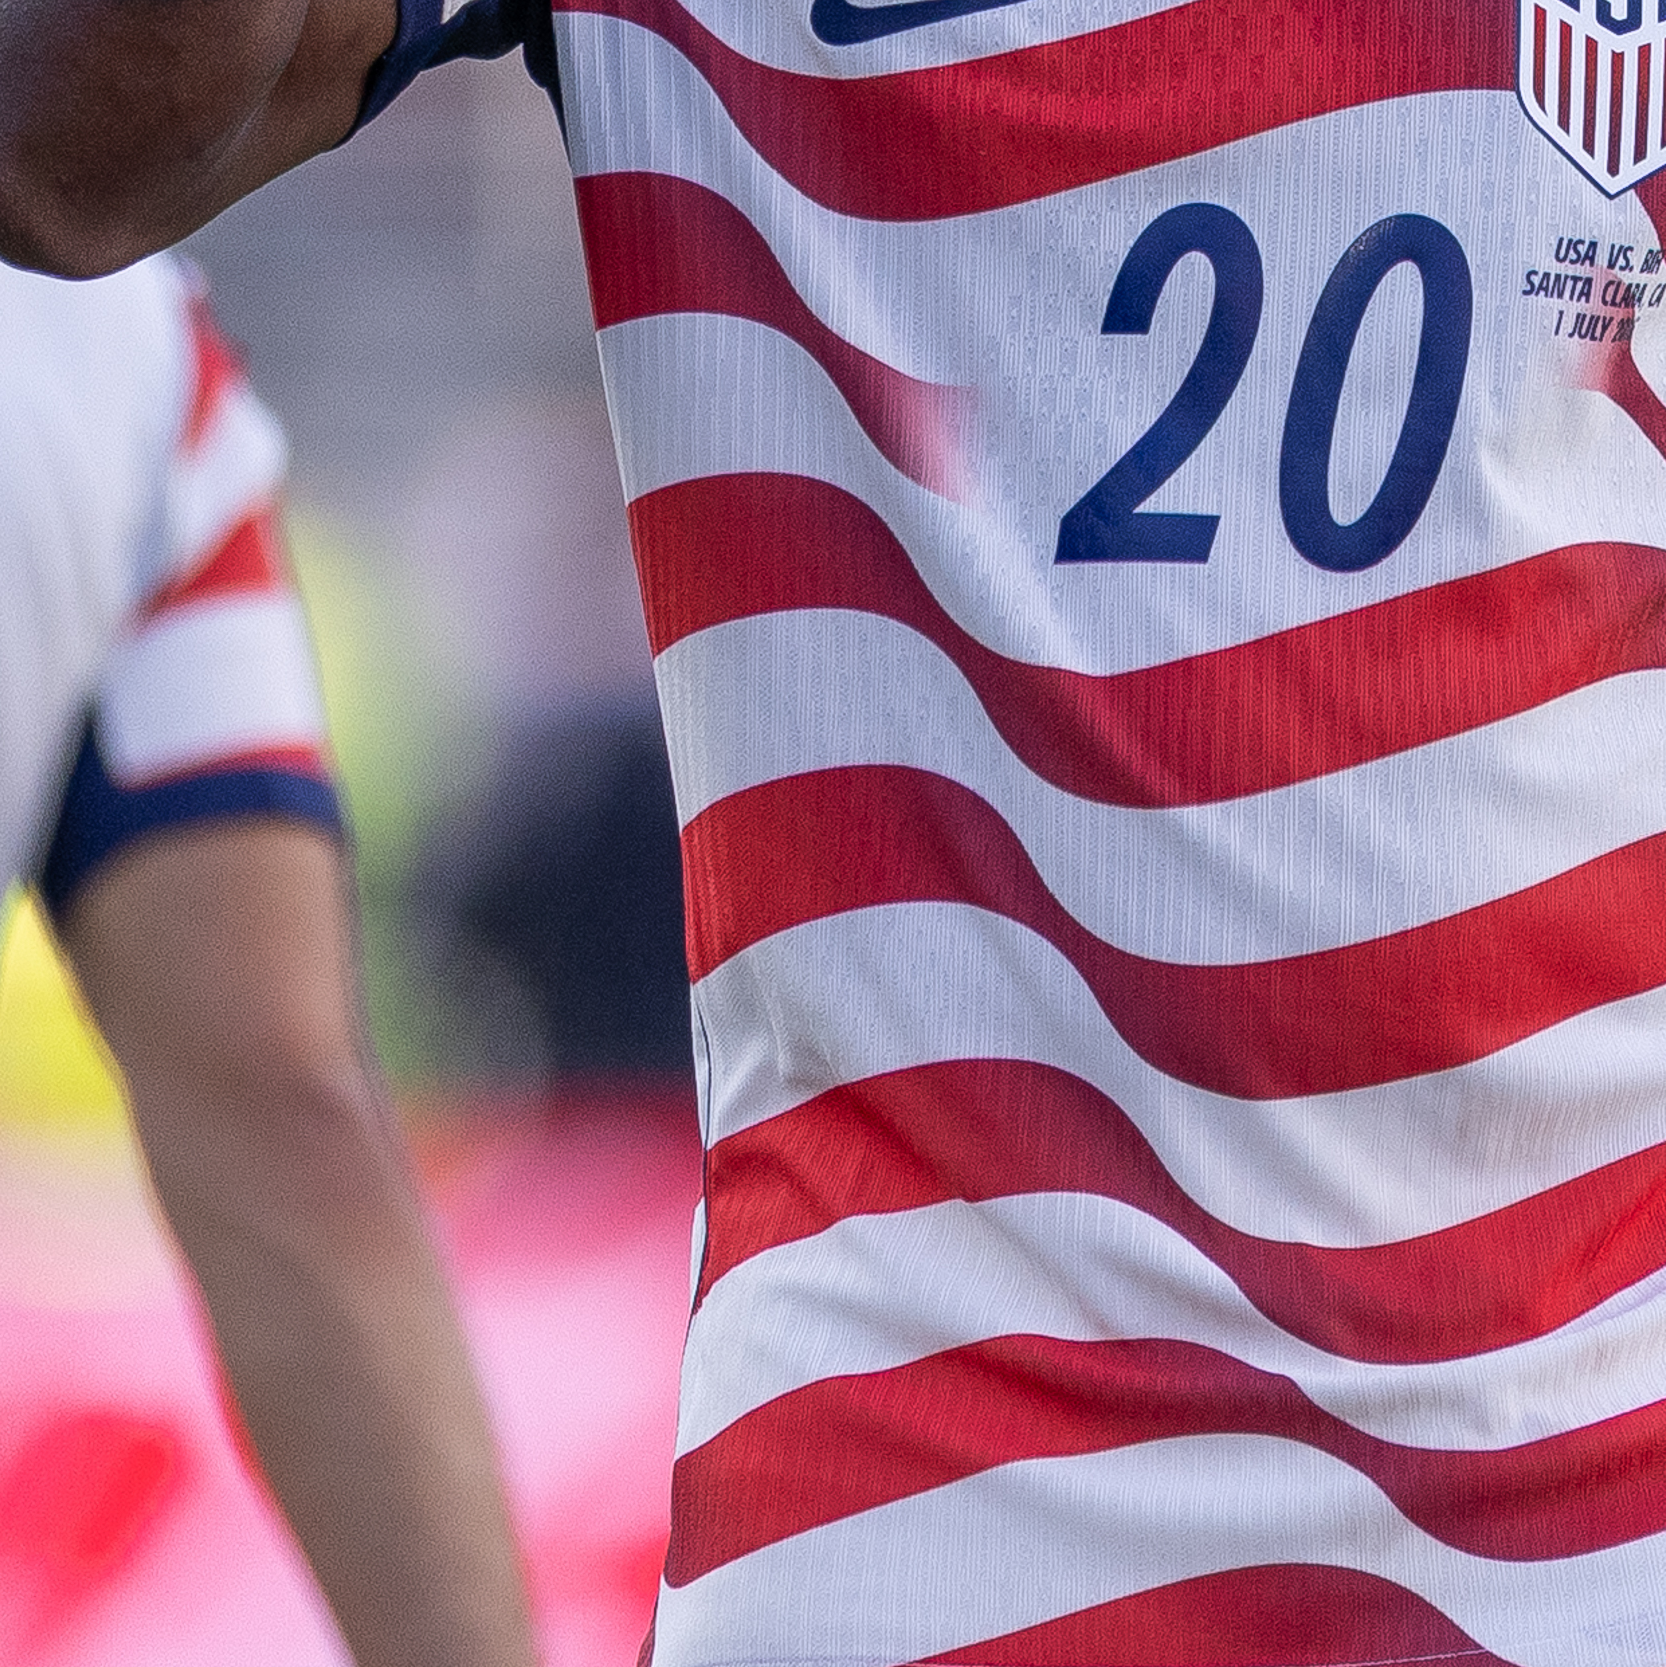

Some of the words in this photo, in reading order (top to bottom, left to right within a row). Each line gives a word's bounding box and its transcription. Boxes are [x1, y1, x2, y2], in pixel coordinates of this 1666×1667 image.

[1554, 237, 1597, 268] USA
[1607, 243, 1634, 273] VS.
[1522, 270, 1594, 304] SANTA
[1554, 310, 1564, 336] 1
[1568, 312, 1614, 343] JULY
[1054, 202, 1473, 573] 20
